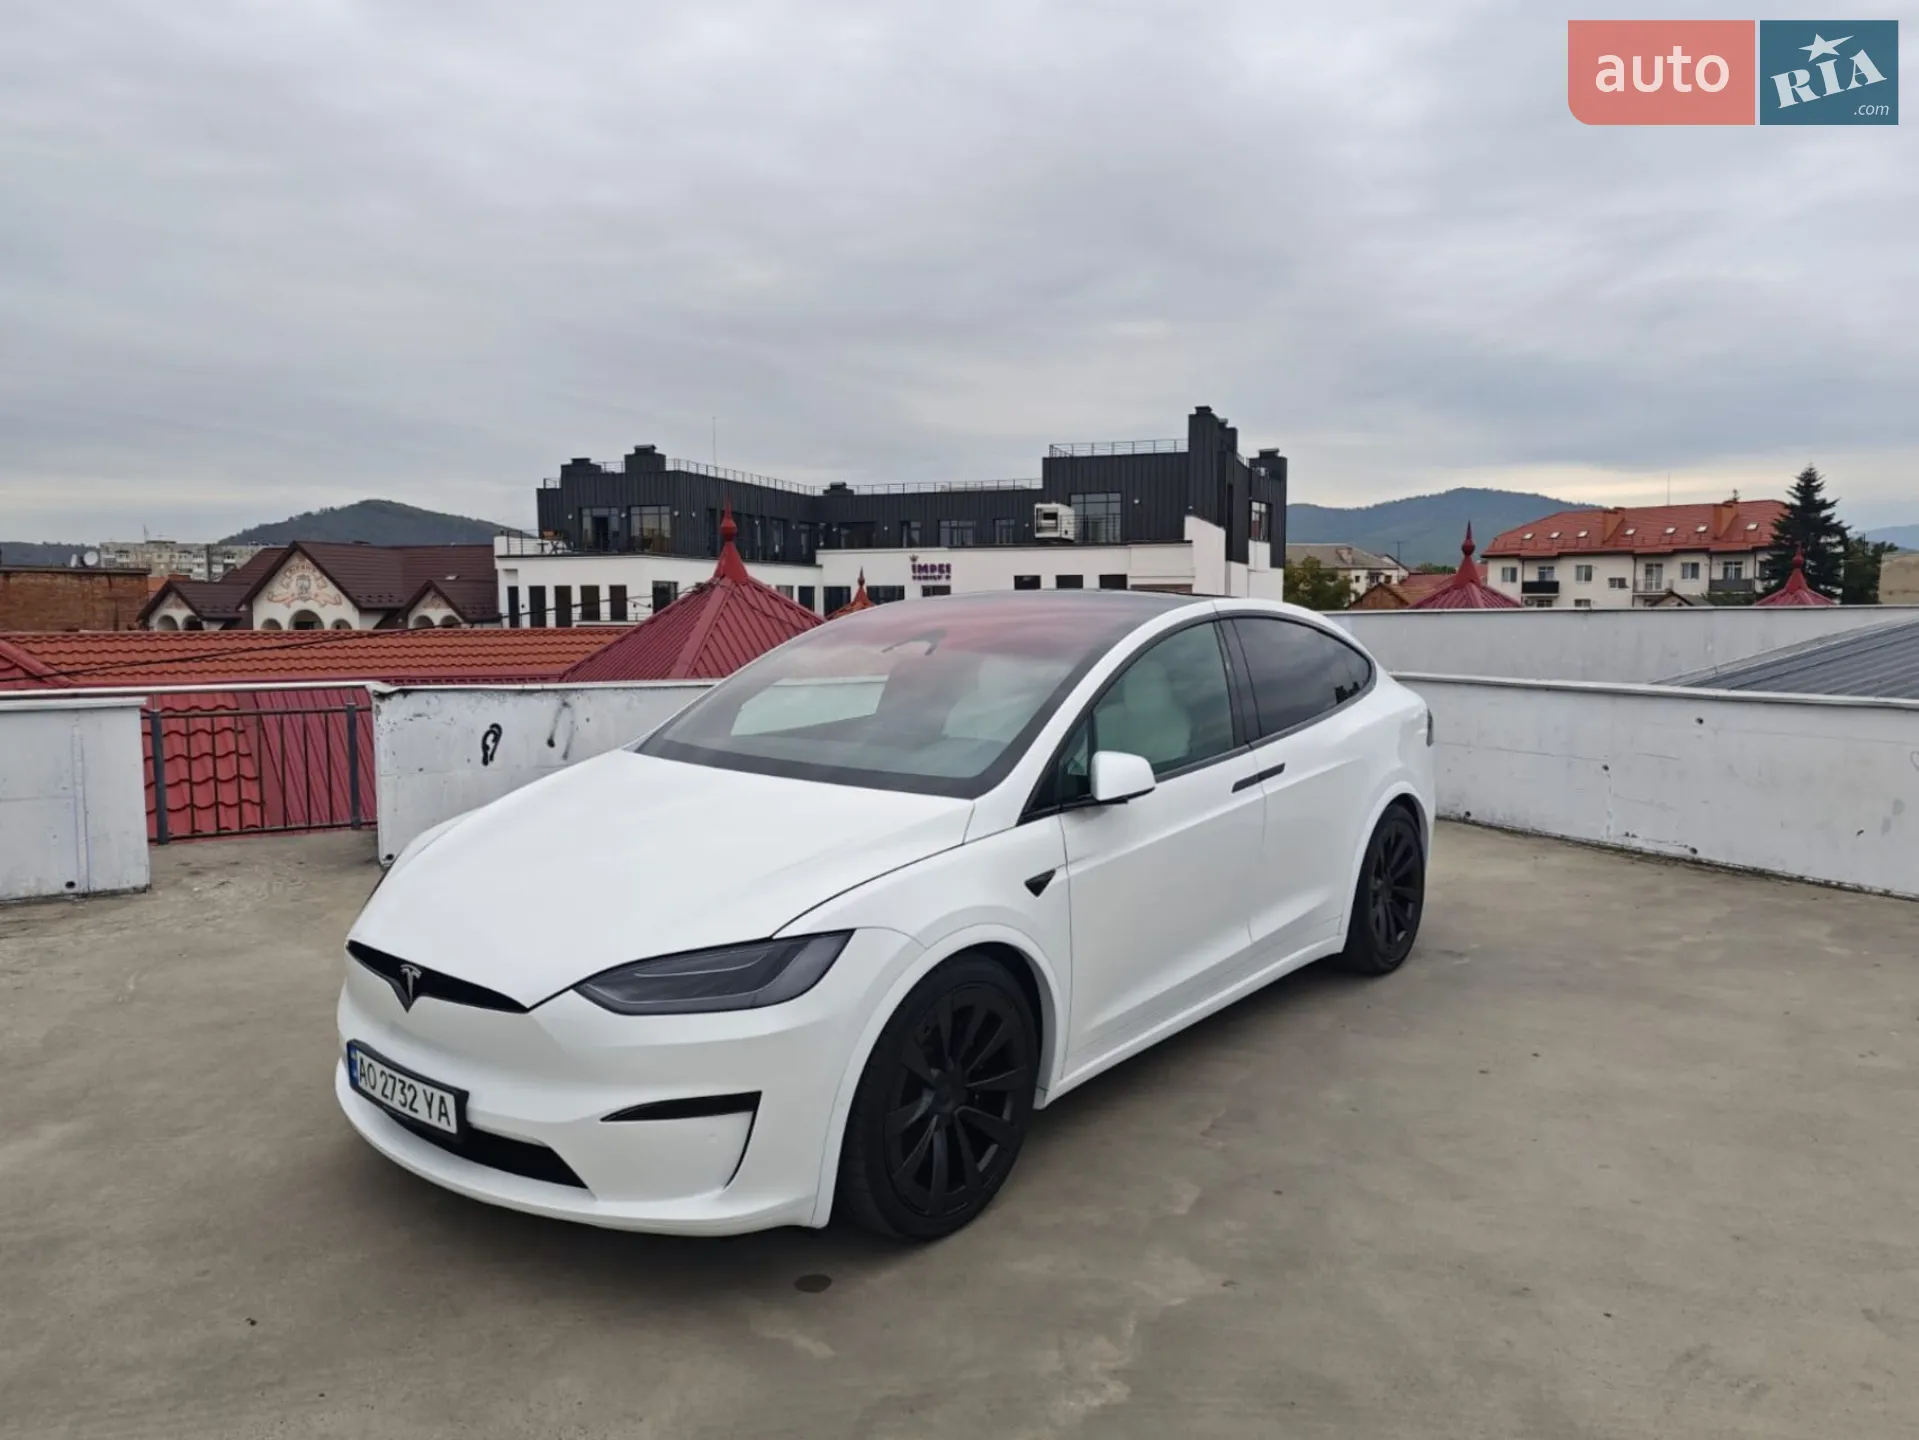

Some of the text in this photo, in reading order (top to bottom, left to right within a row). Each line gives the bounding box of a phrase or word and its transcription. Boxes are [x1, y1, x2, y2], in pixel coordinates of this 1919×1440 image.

[359, 1056, 451, 1127] AO 2732 YA
